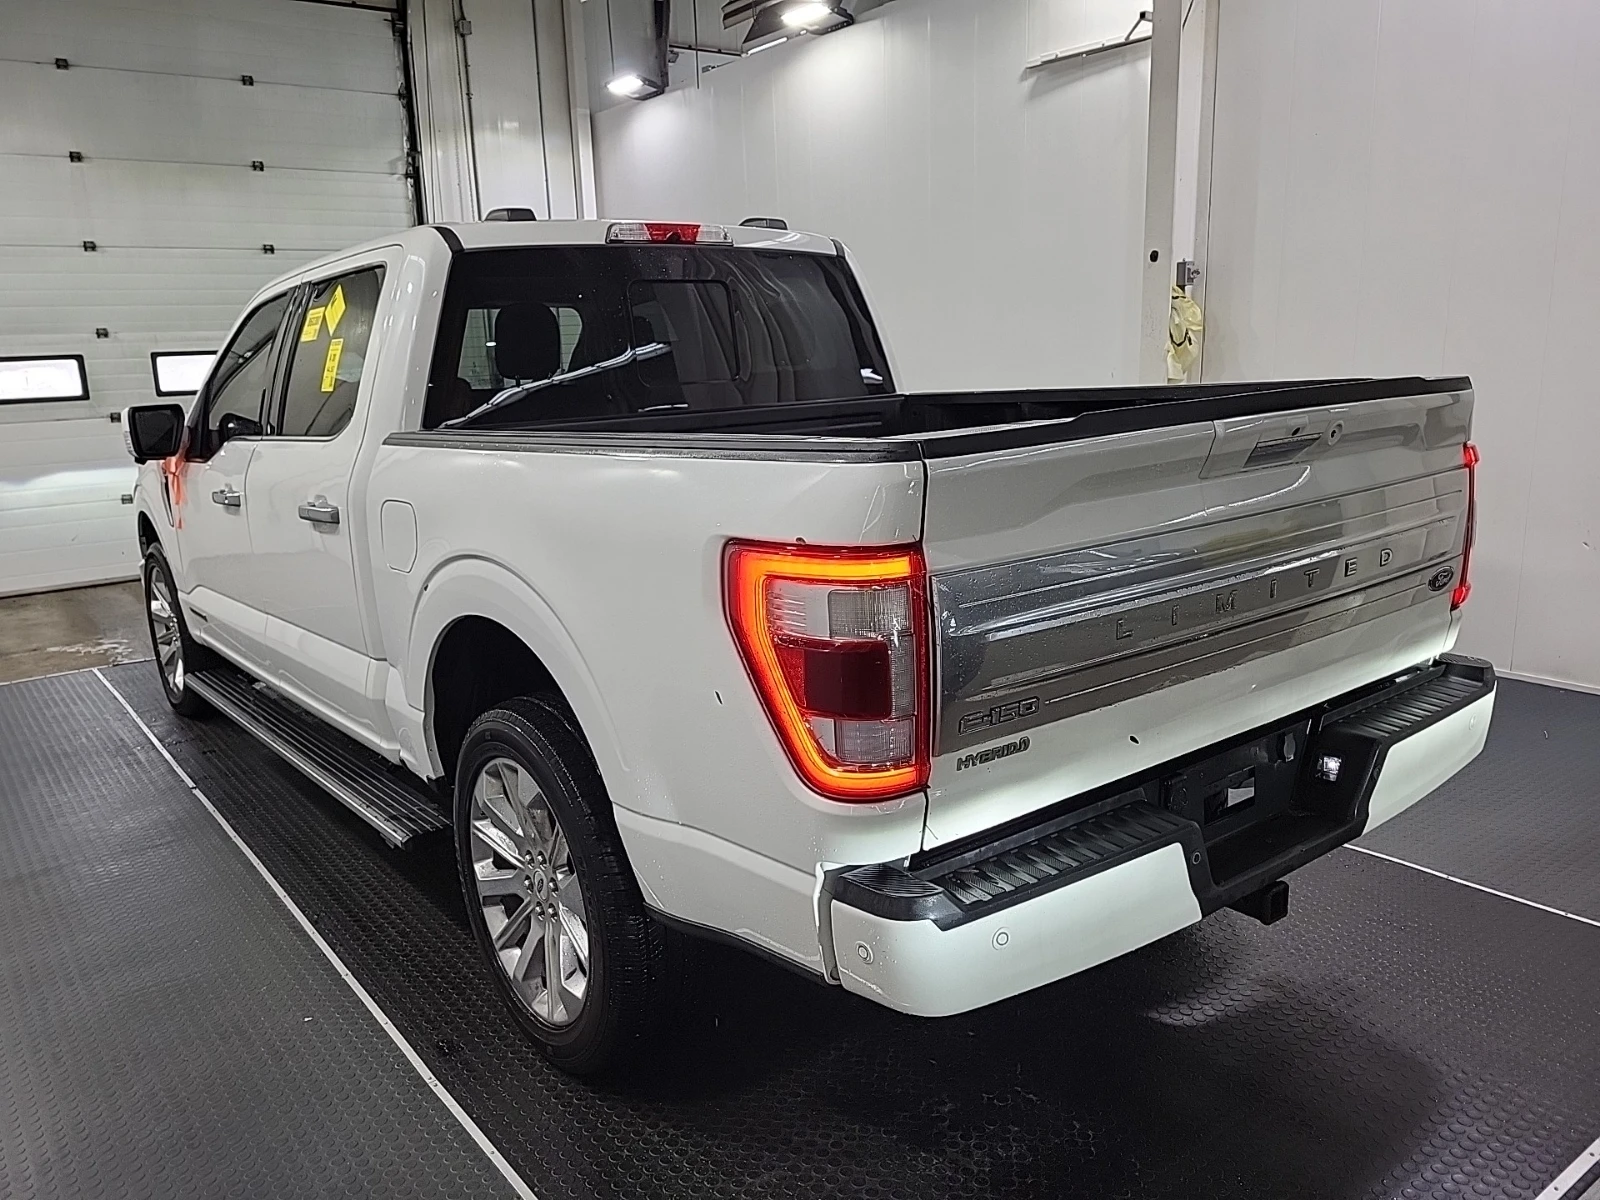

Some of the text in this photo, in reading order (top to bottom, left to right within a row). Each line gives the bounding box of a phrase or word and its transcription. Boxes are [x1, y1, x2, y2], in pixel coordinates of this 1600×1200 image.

[1116, 548, 1393, 640] LIMITED
[958, 696, 1039, 736] F-150
[956, 738, 1024, 771] HYBRID
